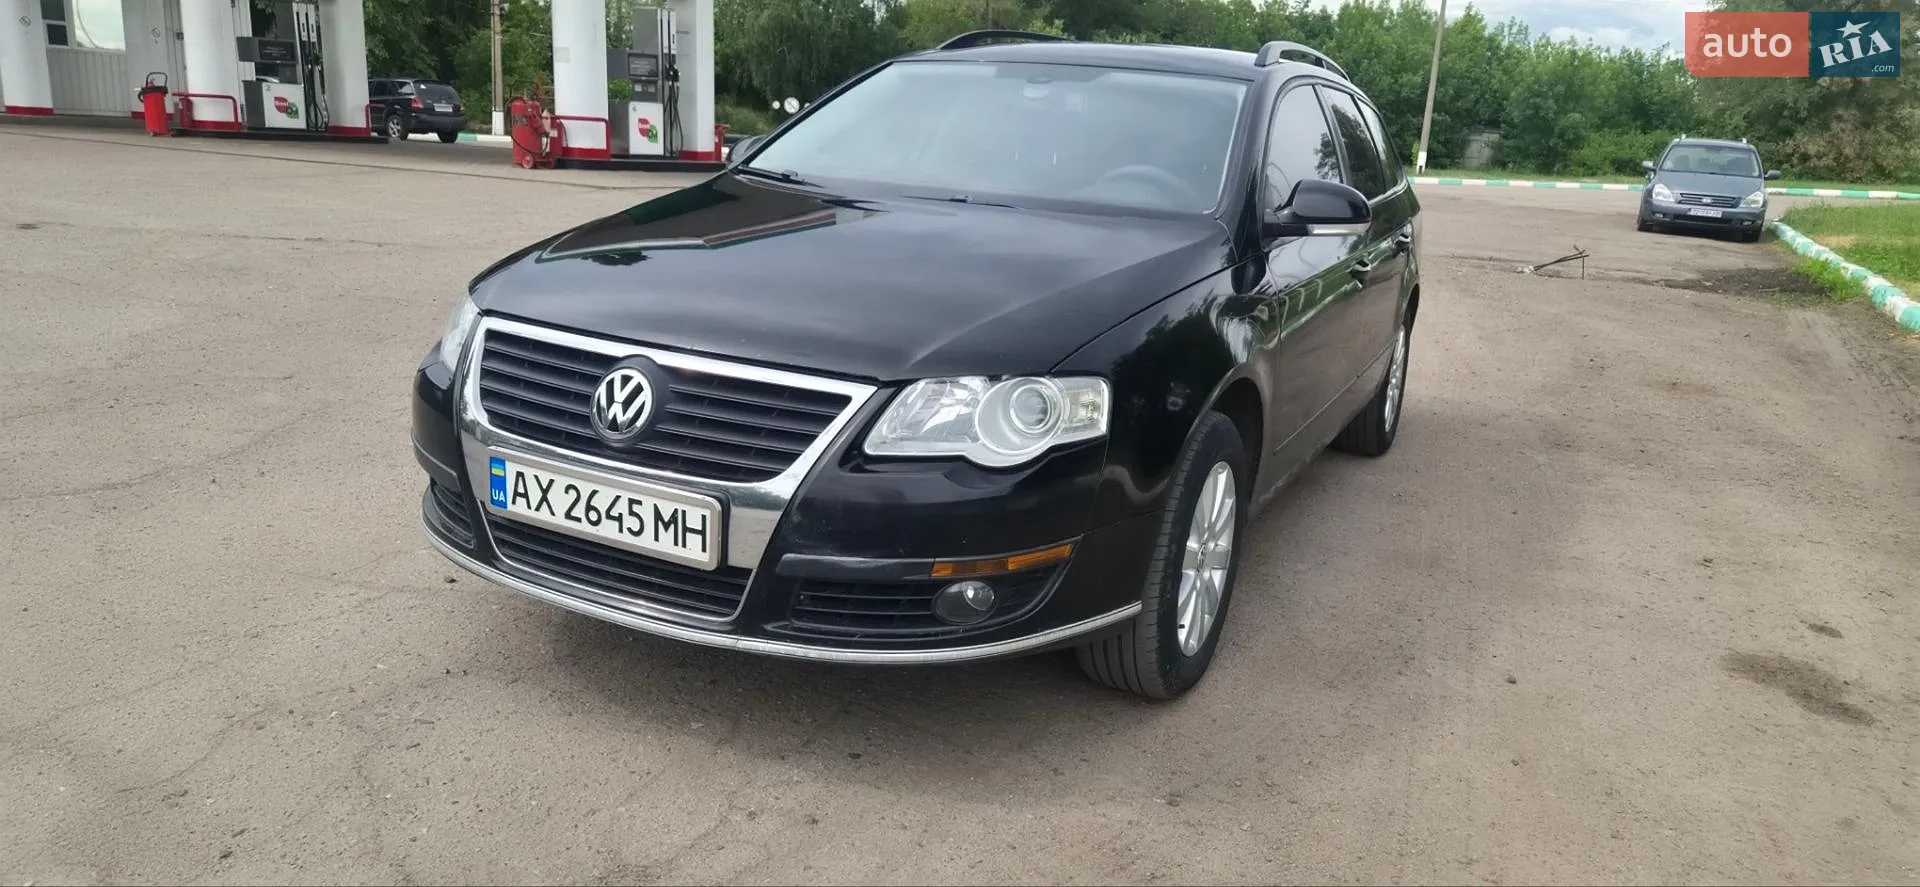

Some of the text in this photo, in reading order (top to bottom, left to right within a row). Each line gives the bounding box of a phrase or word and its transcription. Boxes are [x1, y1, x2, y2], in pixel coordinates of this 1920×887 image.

[492, 488, 505, 502] UA
[511, 470, 707, 553] AX 2645 MH
